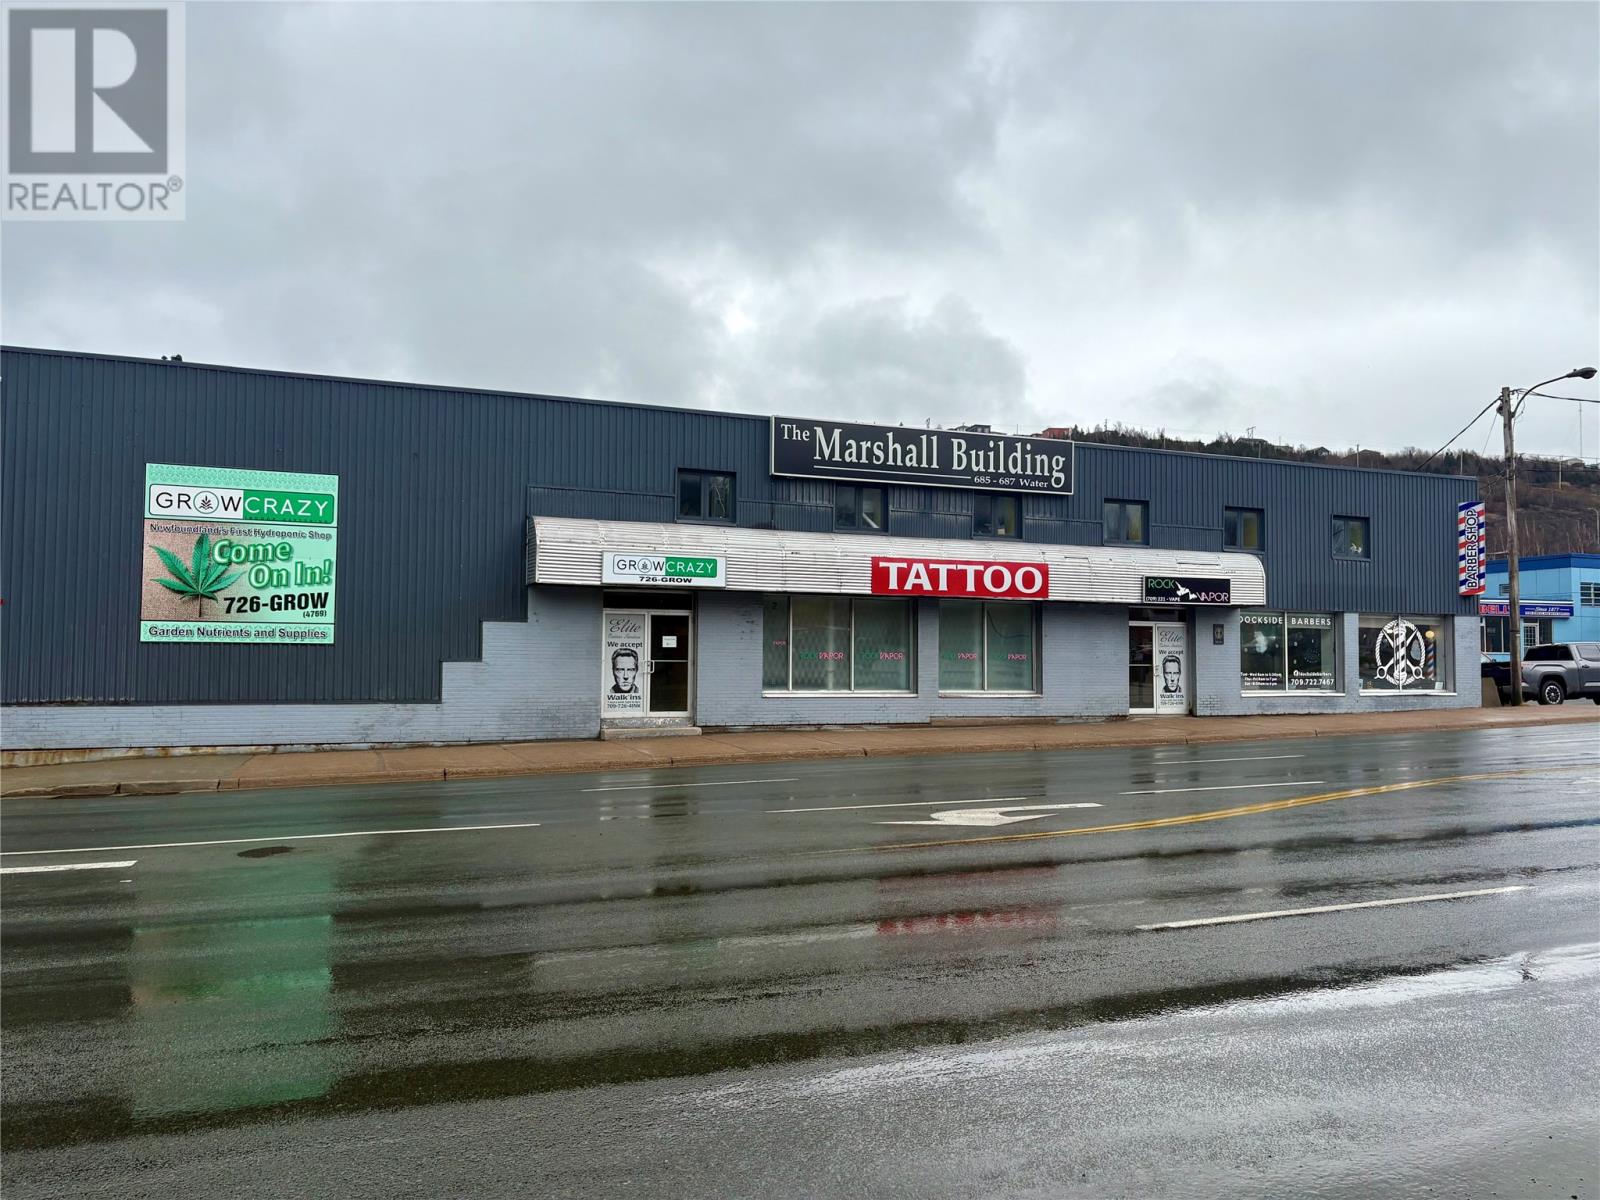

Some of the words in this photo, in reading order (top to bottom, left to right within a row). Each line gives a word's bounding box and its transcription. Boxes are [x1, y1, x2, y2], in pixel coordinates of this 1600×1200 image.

[780, 424, 810, 441] The
[813, 426, 940, 469] Marshall
[951, 438, 1066, 488] Building
[974, 475, 991, 485] 685
[998, 476, 1016, 486] 687
[1019, 477, 1048, 488] Water
[1466, 508, 1479, 541] SHOP
[254, 527, 306, 540] Hydroponic
[308, 530, 332, 541] Shop
[212, 538, 292, 564] Come
[1466, 542, 1479, 589] BARBER
[249, 563, 289, 588] On
[294, 558, 332, 586] In!
[879, 561, 1044, 594] TATTOO
[639, 576, 693, 584] 726-GROW
[1148, 578, 1175, 589] ROCK
[224, 592, 329, 614] 726-GROW
[1196, 592, 1229, 602] VAPOR
[609, 618, 641, 633] Elite
[1291, 617, 1331, 626] BARBERS
[148, 626, 193, 637] Garden
[197, 626, 250, 638] Nutrients
[254, 628, 276, 638] and
[278, 628, 327, 641] Supplies
[1160, 630, 1183, 642] Elite
[620, 641, 643, 649] accept
[819, 651, 844, 661] VAPOR
[880, 651, 904, 661] VAPOR
[957, 652, 977, 660] VAPOR
[1007, 653, 1027, 661] VAPOR
